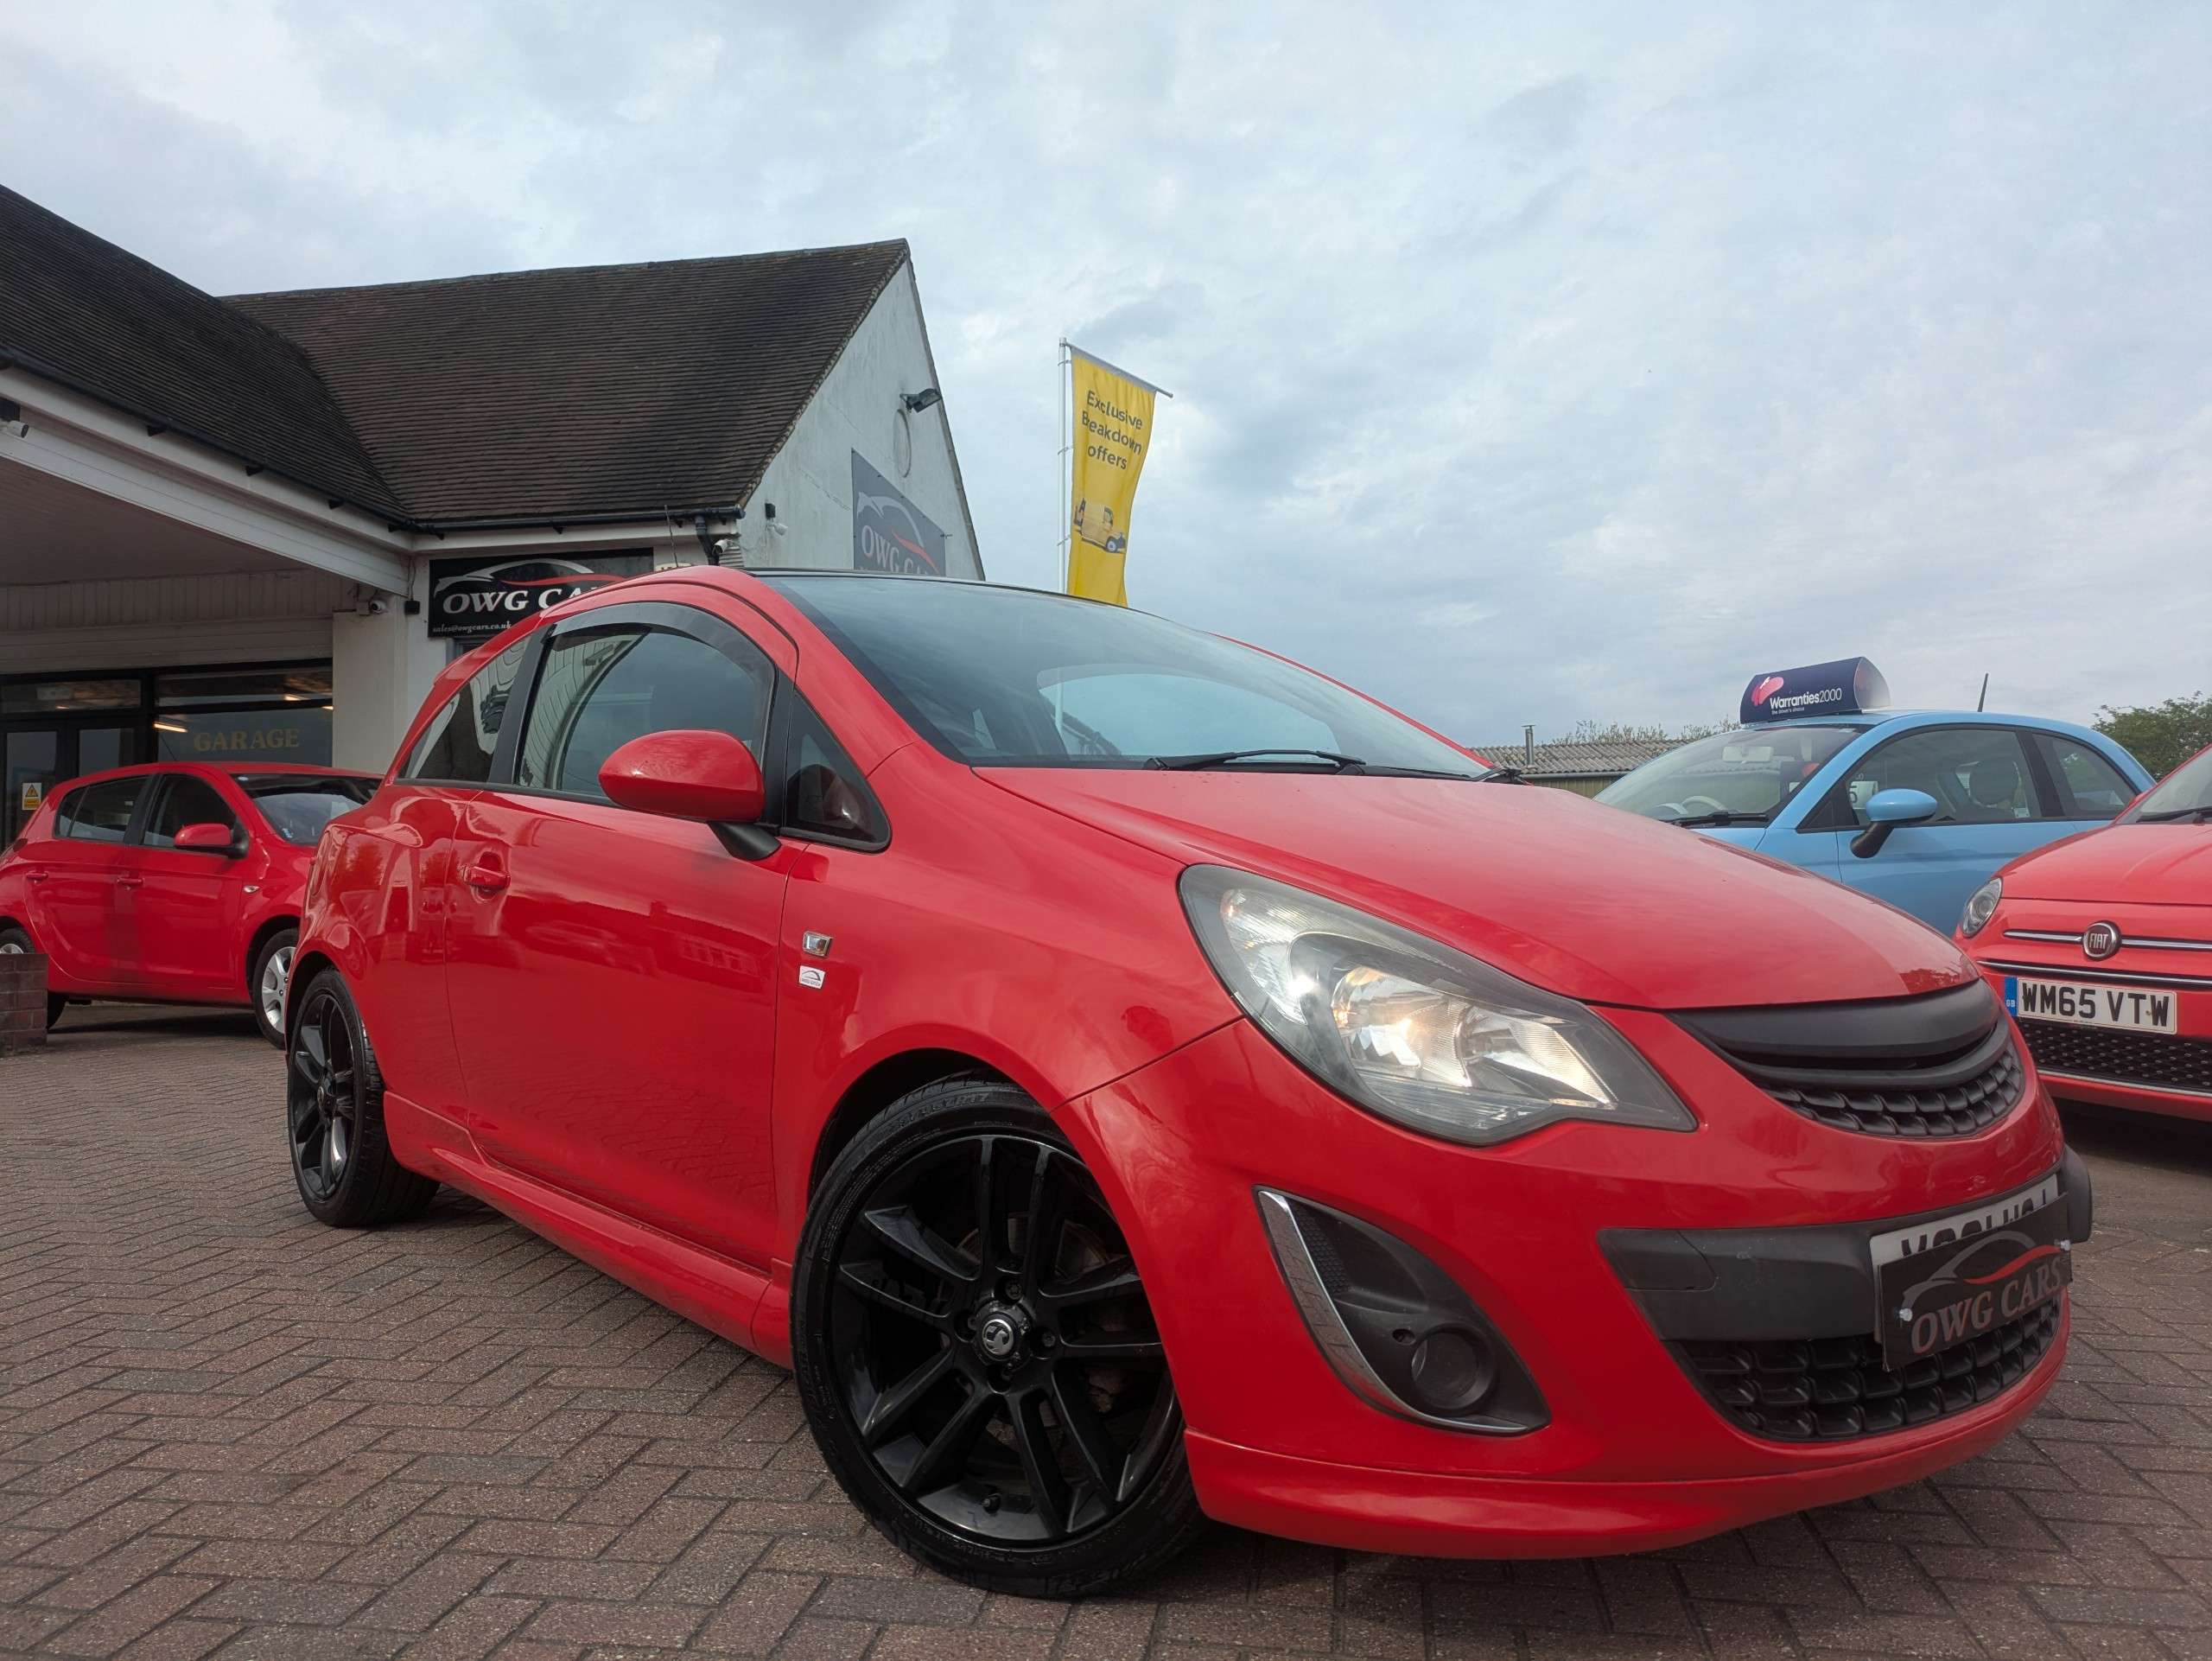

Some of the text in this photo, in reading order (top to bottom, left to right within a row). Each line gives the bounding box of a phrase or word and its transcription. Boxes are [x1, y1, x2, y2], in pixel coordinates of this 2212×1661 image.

[1086, 389, 1143, 430] Exclusive
[1082, 410, 1142, 455] Beakdown
[1087, 444, 1128, 470] offers
[861, 525, 900, 573] OWG
[442, 590, 531, 614] OWG
[1770, 688, 1842, 709] Warranties2000
[193, 729, 300, 752] GARAGE
[2089, 932, 2109, 950] FIAT
[2022, 982, 2170, 1027] WM65 VTW
[1910, 1255, 2063, 1354] OWG CARS
